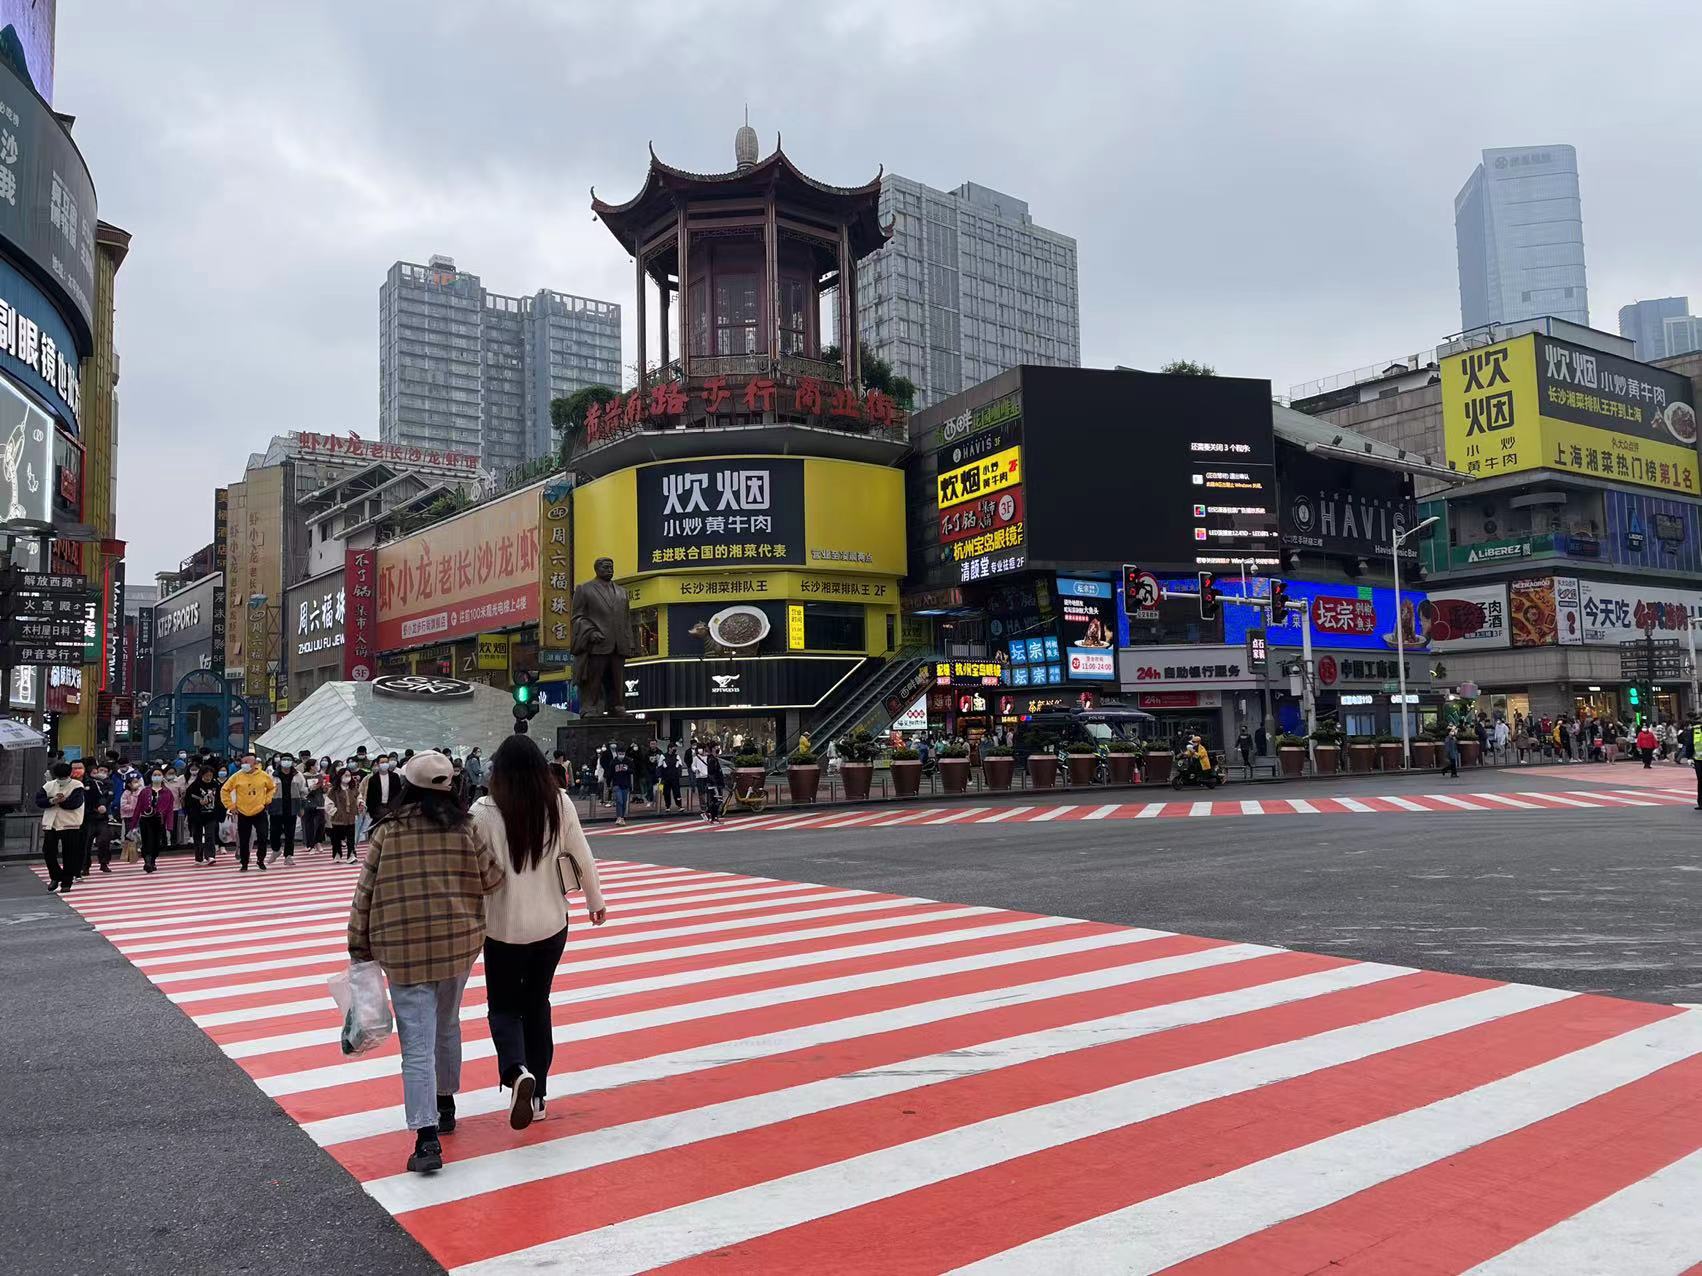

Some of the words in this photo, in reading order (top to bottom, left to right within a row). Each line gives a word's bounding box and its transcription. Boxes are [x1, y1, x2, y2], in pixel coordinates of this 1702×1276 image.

[1545, 344, 1598, 389] 炊烟
[1601, 371, 1666, 406] 小炒黄牛肉
[1461, 347, 1515, 437] 炊烟
[1547, 385, 1643, 424] 长沙湘菜排队王开到上海
[963, 436, 992, 459] HAVIS
[1467, 436, 1516, 457] 小炒
[983, 461, 999, 476] 小炒
[1467, 453, 1518, 474] 黄牛肉
[1554, 442, 1693, 489] 上海湘菜热门榜第1名
[940, 466, 981, 503] 炊烟
[983, 472, 1008, 489] 黄牛肉
[662, 470, 770, 515] 炊烟
[1001, 500, 1012, 516] 3F
[663, 515, 772, 537] 小炒黄牛肉
[1320, 499, 1406, 546] HAVIS
[652, 544, 787, 563] 走进联合国的湘菜代表
[953, 528, 1018, 561] 杭州宝岛眼镜
[961, 557, 990, 582] 清颜堂
[23, 575, 74, 588] 解放西路
[550, 527, 568, 640] 周六福珠宝
[679, 580, 768, 595] 长沙湘菜排队王
[800, 580, 870, 596] 长沙湘菜排队王
[874, 585, 887, 597] 2F
[24, 600, 71, 611] 火宫殿
[1317, 600, 1354, 630] 坛宗
[1584, 596, 1631, 628] 今天吃
[173, 602, 199, 632] SPORTS
[22, 625, 70, 636] 木村屋日料
[1494, 630, 1503, 638] 3F
[1597, 631, 1606, 640] 3F
[298, 641, 313, 655] ZHOU
[323, 637, 331, 648] FU
[479, 642, 507, 653] 炊烟
[1011, 642, 1044, 661] 坛宗
[1252, 639, 1264, 648] 点石
[22, 649, 70, 660] 伊音琴行
[1014, 667, 1045, 684] 坛宗
[1137, 667, 1161, 680] 24h
[1164, 665, 1240, 679] 自助银行服务
